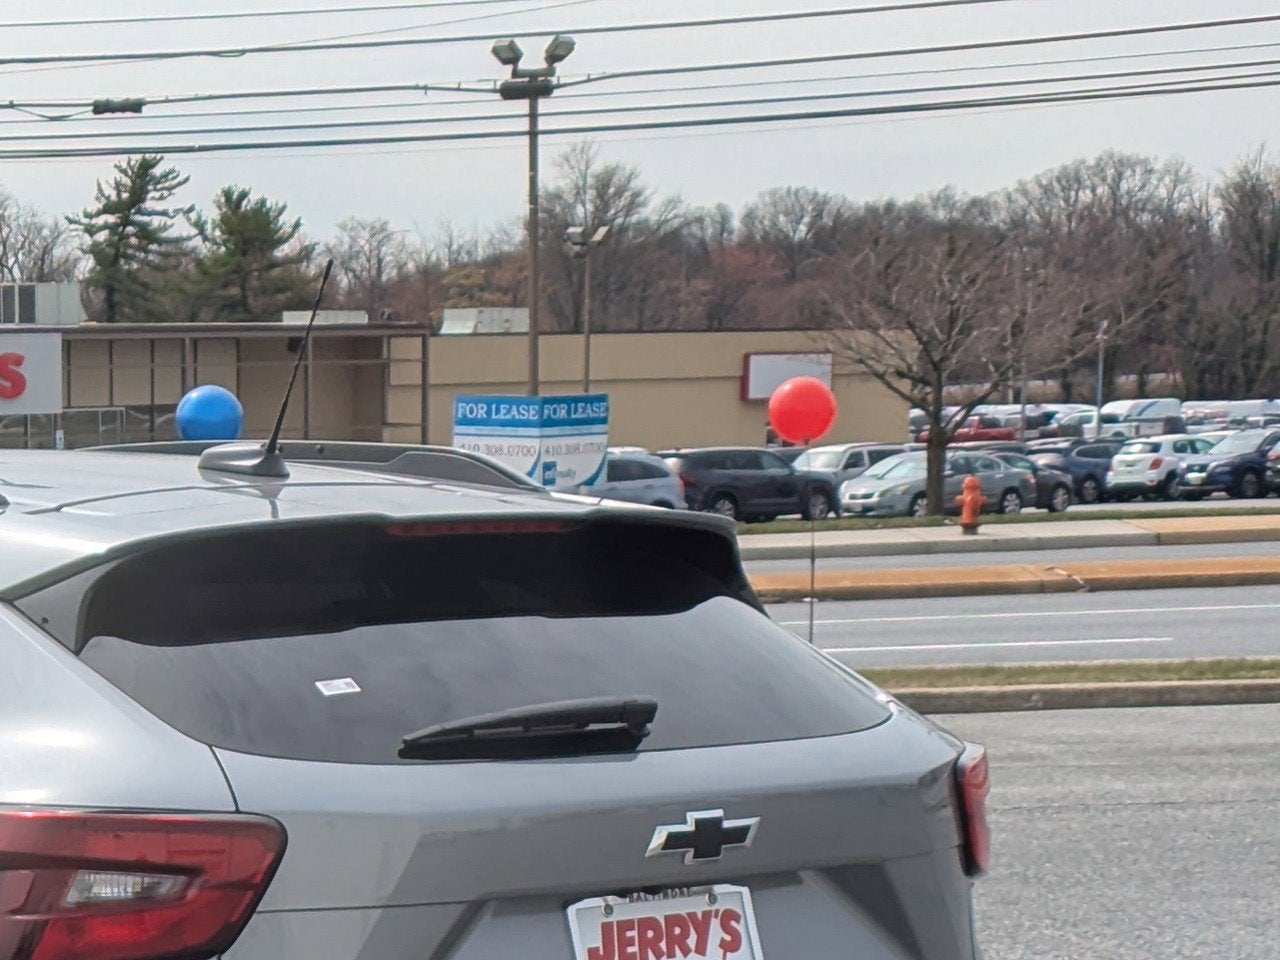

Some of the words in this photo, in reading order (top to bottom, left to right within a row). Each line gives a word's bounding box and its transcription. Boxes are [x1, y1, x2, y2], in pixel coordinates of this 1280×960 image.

[457, 403, 487, 419] FOR
[491, 403, 539, 420] LEASE
[543, 403, 568, 419] FOR
[571, 401, 608, 418] LEASE
[460, 443, 537, 457] 410308.0700
[544, 441, 605, 456] 410.308.
